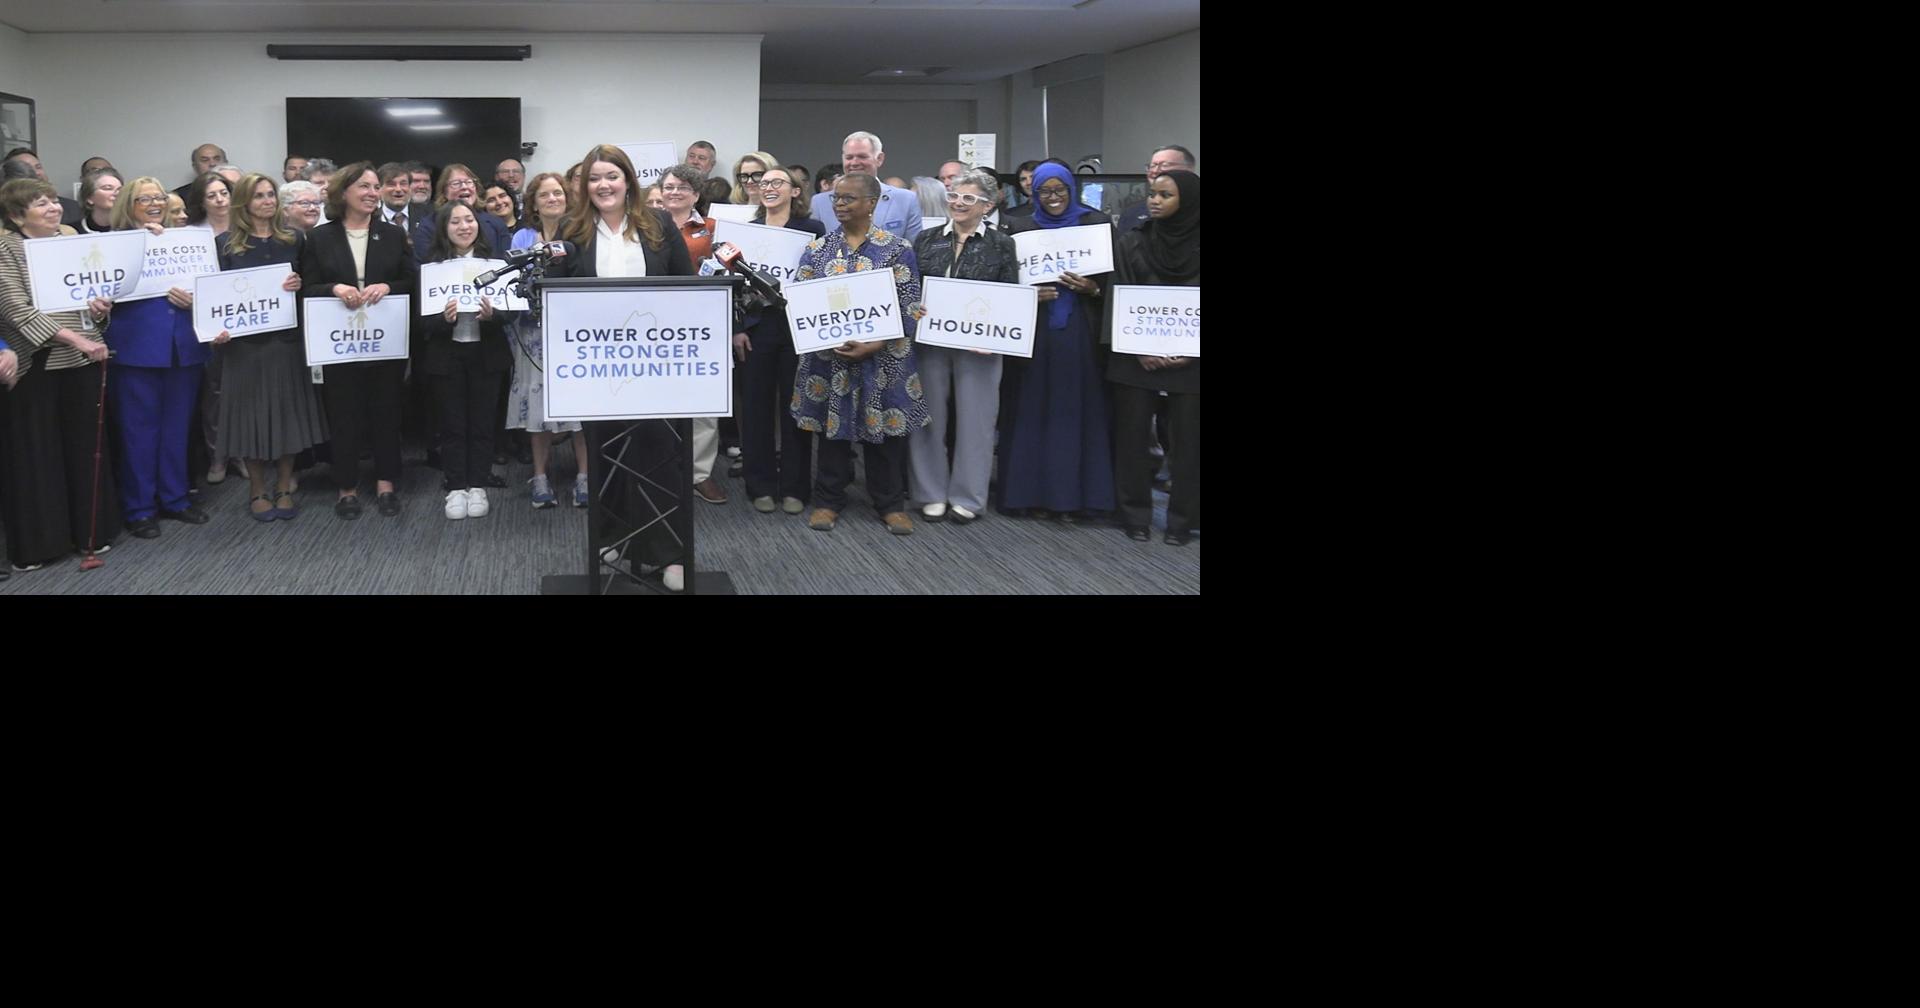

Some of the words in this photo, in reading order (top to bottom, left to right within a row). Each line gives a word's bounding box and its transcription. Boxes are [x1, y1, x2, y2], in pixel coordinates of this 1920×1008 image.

[172, 245, 208, 255] COSTS
[1019, 248, 1092, 268] HEALTH
[148, 256, 203, 266] RONGER
[1028, 259, 1079, 276] CARE
[63, 268, 125, 287] CHILD
[142, 265, 215, 278] MMUNITIES
[750, 262, 795, 279] ERGY
[70, 283, 121, 301] CARE
[428, 284, 519, 297] EVERYDAY
[211, 297, 280, 318] HEALTH
[1129, 306, 1179, 315] LOWER
[1184, 307, 1200, 317] CO
[223, 312, 270, 330] CARE
[796, 303, 892, 331] EVERYDAY
[1136, 316, 1200, 327] STRONG
[329, 328, 385, 342] CHILD
[564, 328, 638, 343] LOWER
[646, 327, 711, 342] COSTS
[817, 320, 875, 341] COSTS
[929, 318, 1022, 341] HOUSING
[1122, 326, 1200, 337] COMMUN
[333, 341, 381, 355] CARE
[576, 344, 700, 360] STRONGER
[555, 361, 720, 379] COMMUNITIES
